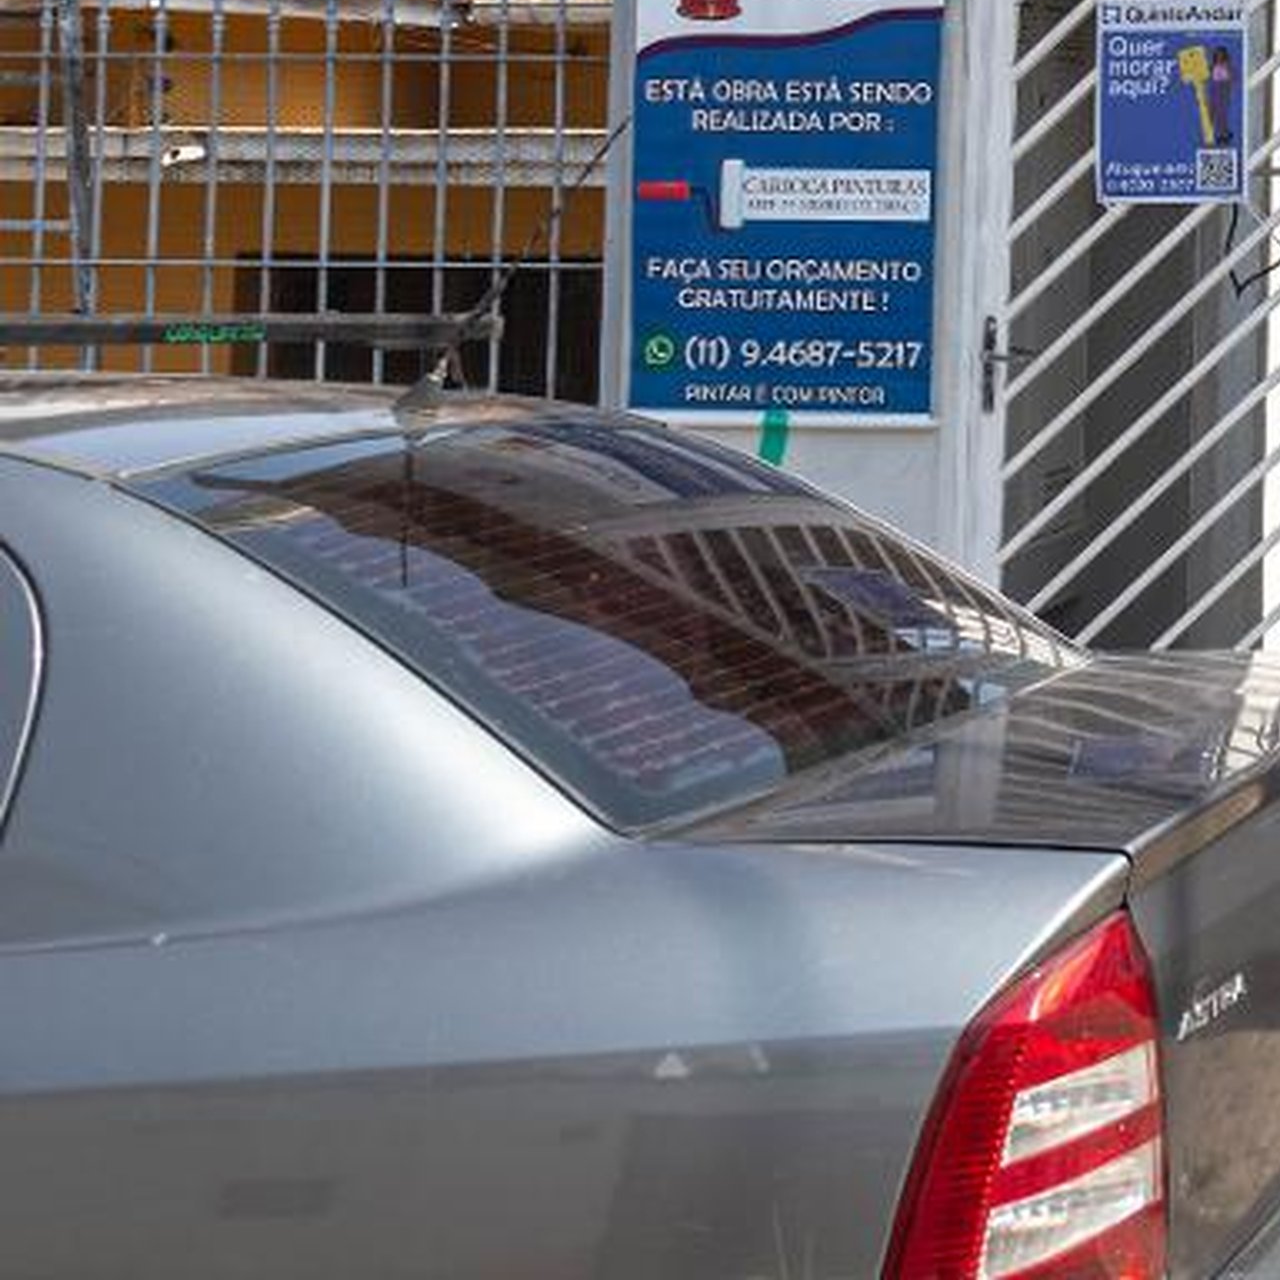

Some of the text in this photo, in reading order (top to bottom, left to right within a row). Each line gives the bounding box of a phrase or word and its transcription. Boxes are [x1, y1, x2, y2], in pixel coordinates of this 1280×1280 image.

[1108, 36, 1165, 57] Quer
[1108, 60, 1177, 76] morar
[712, 79, 779, 103] OBRA
[785, 75, 842, 103] ESTÁ
[849, 81, 932, 105] SENDO
[691, 109, 824, 131] REALIZADA
[828, 111, 881, 132] POR
[648, 257, 923, 284] FAÇA SEU ORÇAMENTO
[677, 288, 876, 312] GRATUITAMENTE
[684, 335, 923, 369] (11) 9.4687-5217
[685, 384, 752, 402] PINTAR
